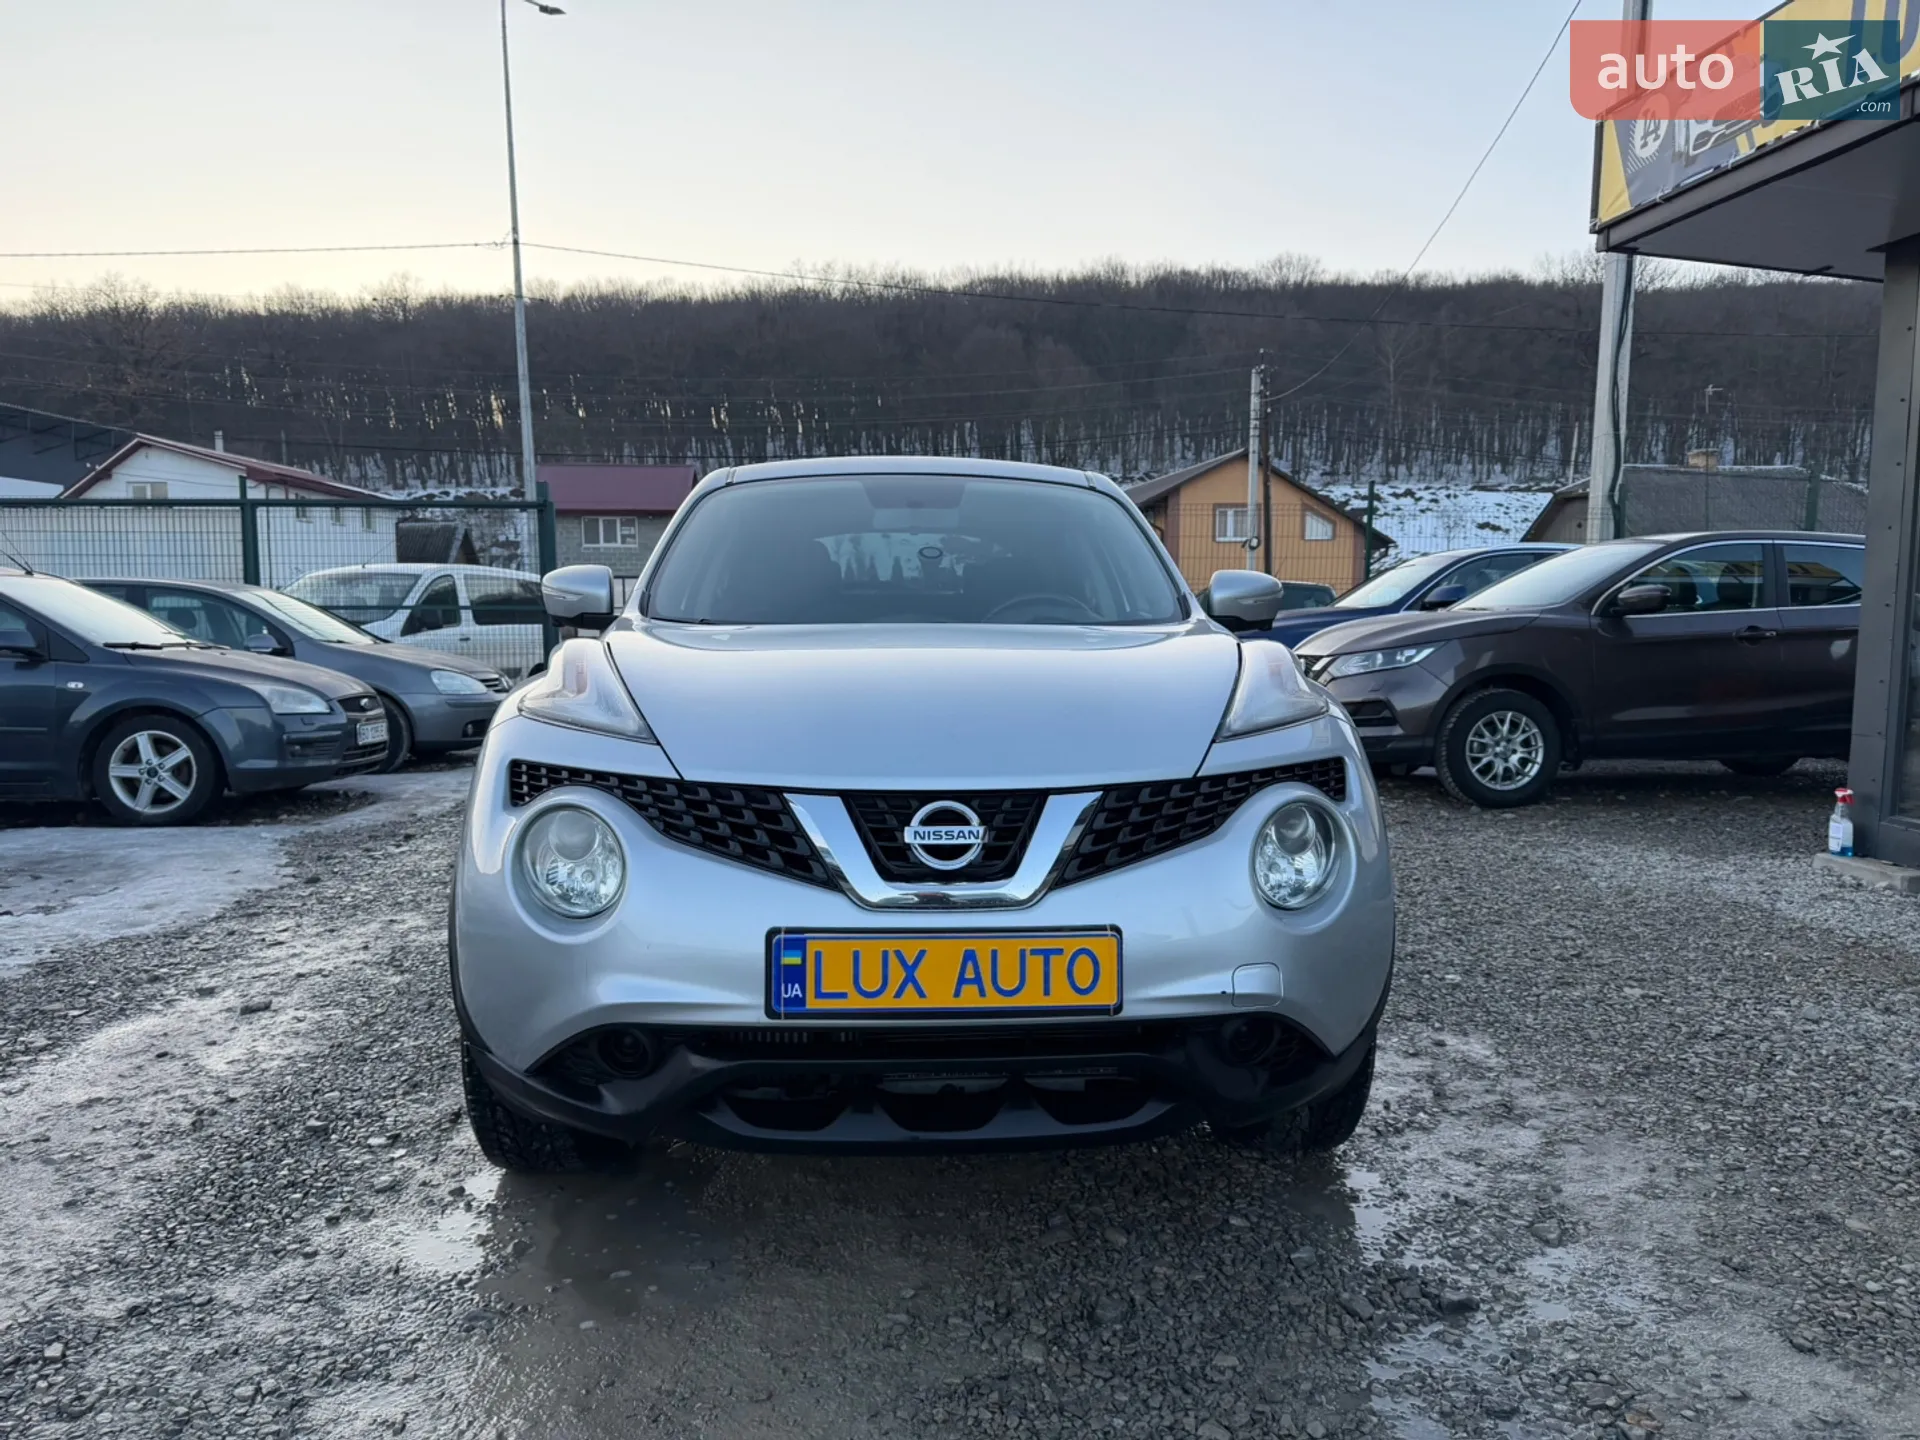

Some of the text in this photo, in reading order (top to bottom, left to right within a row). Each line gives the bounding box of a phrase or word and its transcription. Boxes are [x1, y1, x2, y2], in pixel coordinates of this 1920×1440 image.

[913, 829, 980, 841] NISSAN
[814, 947, 1101, 1000] LUX AUTO
[781, 983, 803, 998] UA
